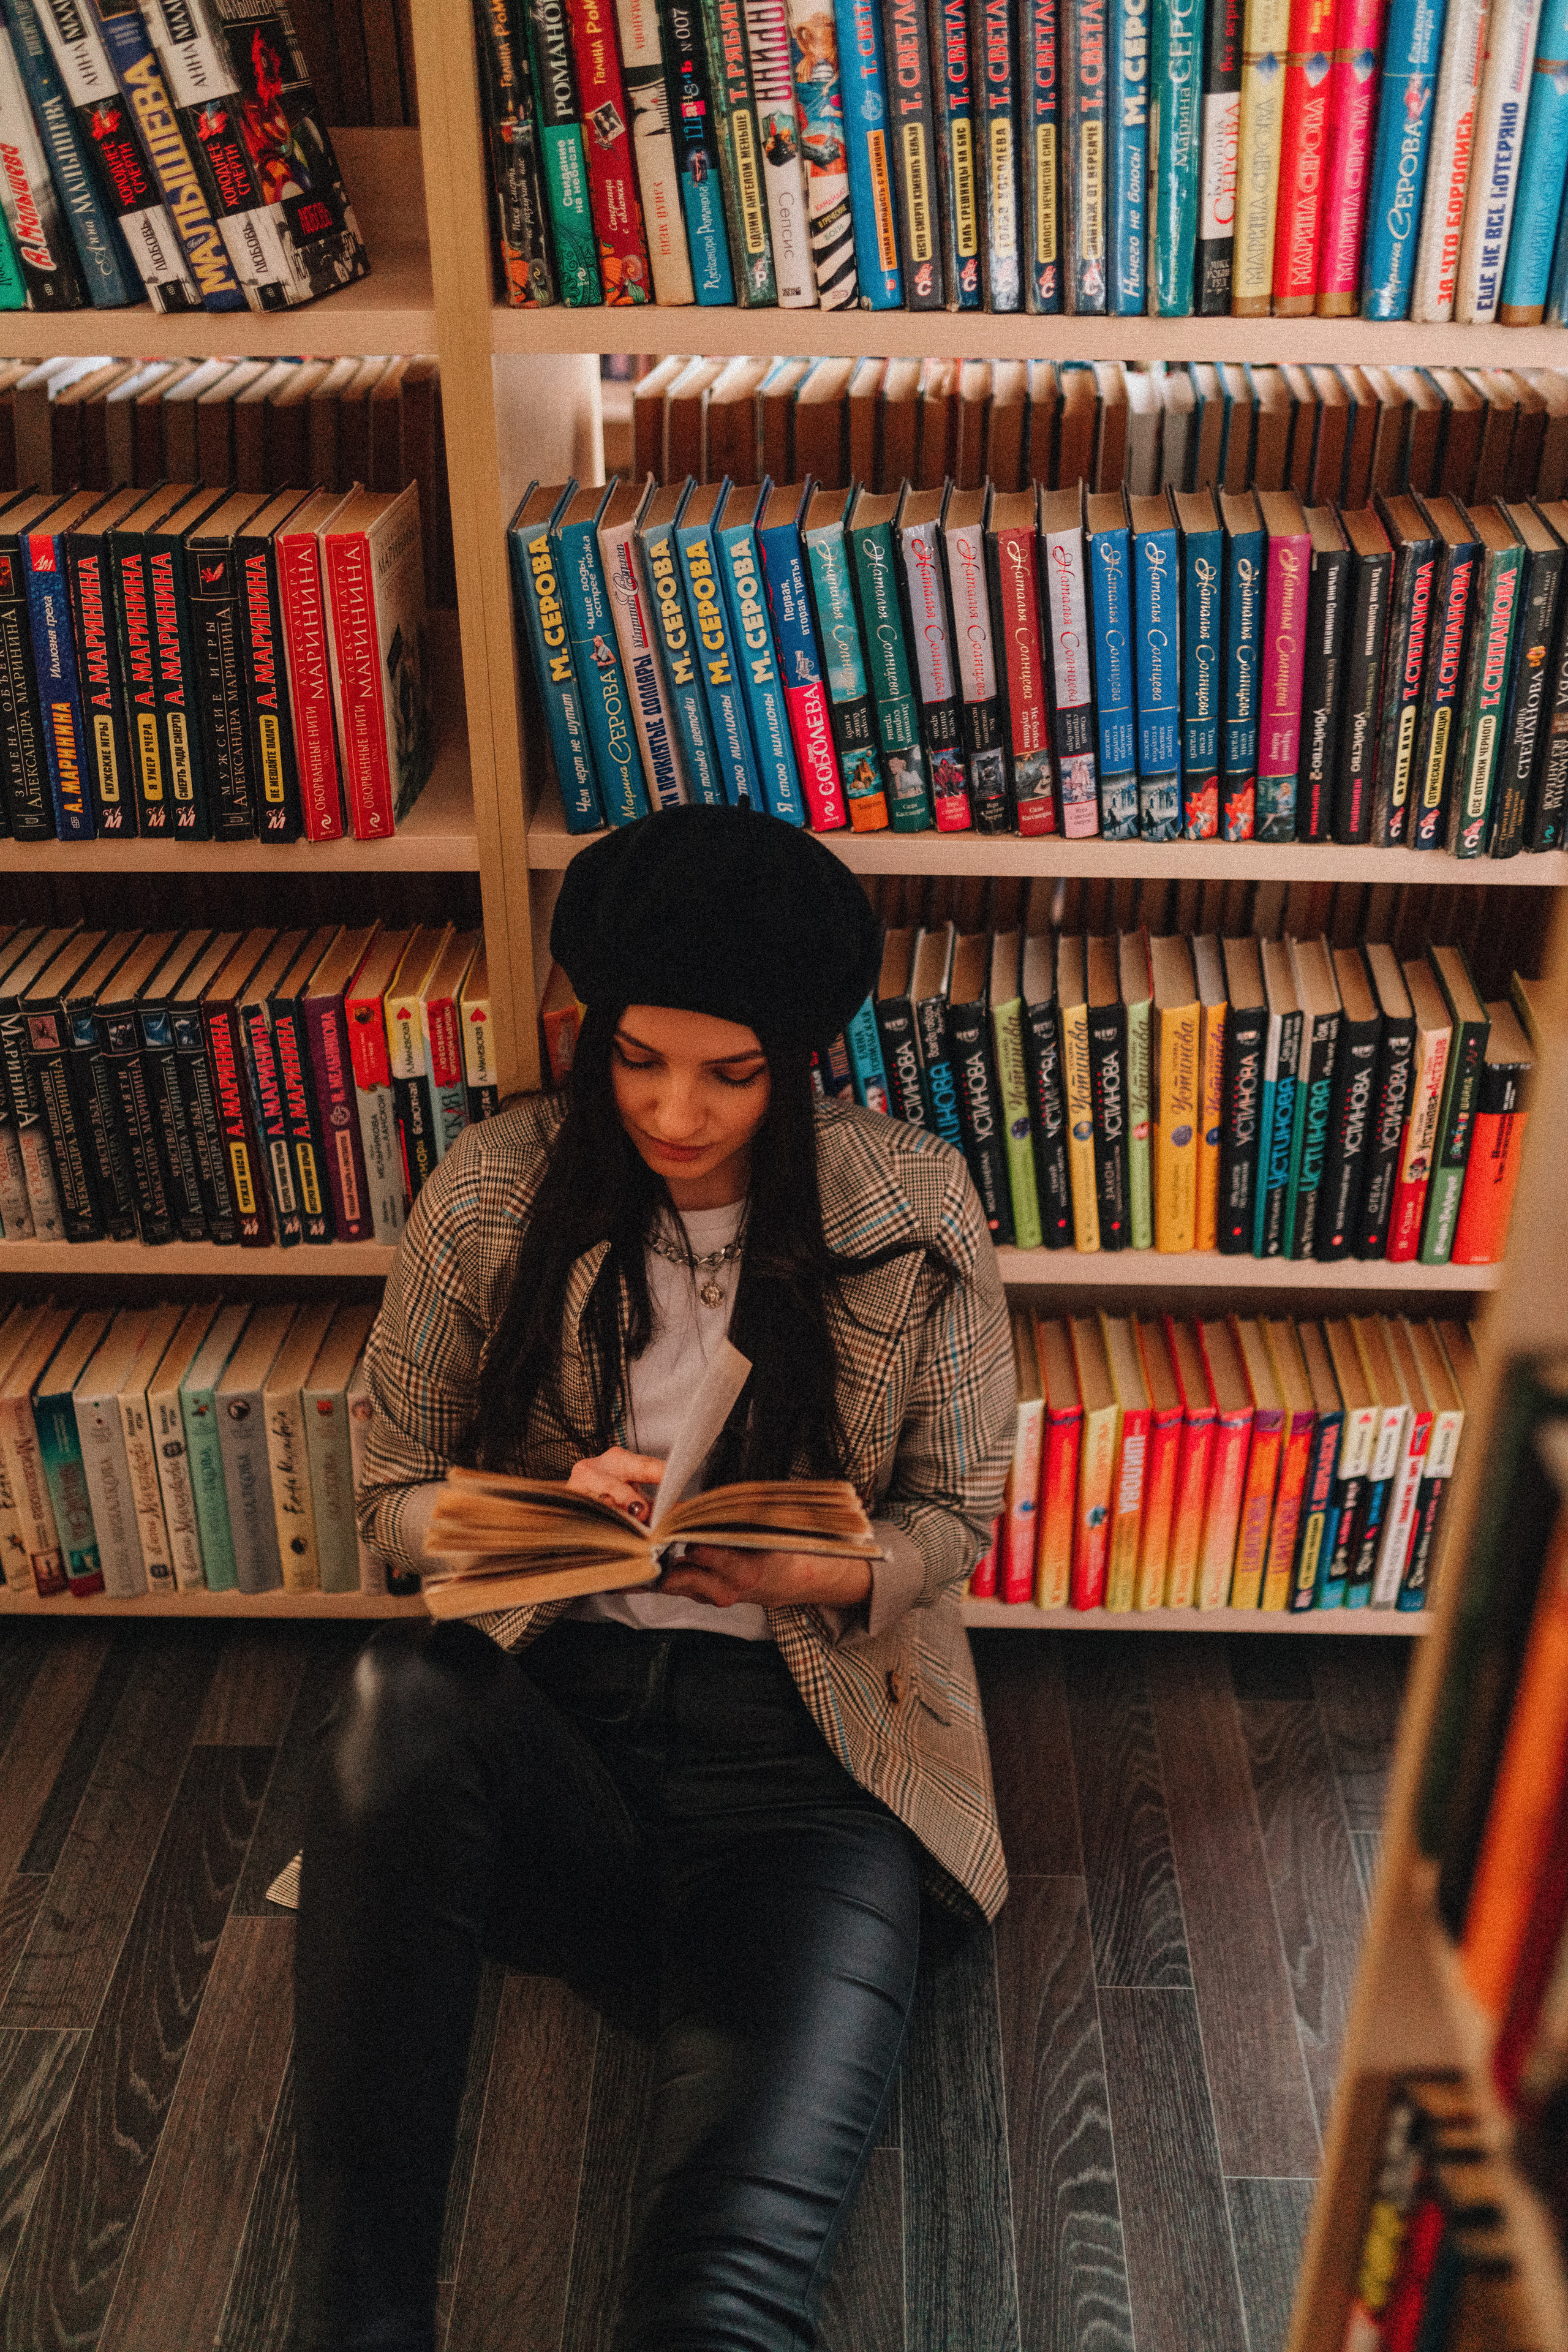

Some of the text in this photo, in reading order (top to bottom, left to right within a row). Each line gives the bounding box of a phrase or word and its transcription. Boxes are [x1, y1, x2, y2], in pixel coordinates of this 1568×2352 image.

[72, 42, 100, 86] АННА
[181, 42, 209, 88] АННА
[101, 141, 137, 206] ХОЛОДНЕЕ
[119, 141, 148, 194] СМЕРТИ
[123, 53, 238, 295] МАЛЫШЕВА
[206, 141, 241, 208] ХОЛОДНЕЕ
[225, 143, 251, 195] СМЕРТИ
[557, 140, 573, 206] Свидание
[1175, 87, 1192, 168] Марина
[1490, 102, 1518, 198] ПОТЕРЯНО
[41, 95, 112, 275] Анна МАЛЫШЕВА
[567, 138, 583, 213] на небесах
[605, 179, 618, 231] Соперница
[653, 181, 671, 255] УЗНАЙ МЕНЯ
[736, 115, 762, 247] ОДНИМ АНГЕЛОМ МЕНЬШЕ
[908, 126, 927, 258] МЕСТО СМЕРТИ ИЗМЕНИТЬ НЕЛЬЗЯ
[956, 127, 972, 249] РОЛЬ ГРЕШНИЦЫ НА БИС
[1123, 146, 1141, 297] Ничего не боюсь!
[1292, 97, 1322, 285] МАРИНА СЕРОВА
[1438, 96, 1476, 305] ЗА ЧТО БОРОЛИСЬ...
[1485, 204, 1506, 239] ВСЕ
[778, 192, 794, 258] Сепсис
[1482, 245, 1500, 267] НЕ
[298, 548, 325, 699] МАРИНИНА
[345, 546, 374, 697] МАРИНИНА
[529, 534, 571, 681] М. СЕРОВА
[578, 556, 596, 630] Чище воды,
[581, 535, 602, 617] острее ножа
[649, 538, 694, 684] М. СЕРОВА
[730, 538, 774, 684] М. СЕРОВА
[780, 579, 794, 622] Первая,
[790, 559, 810, 635] вторая, третья
[862, 539, 900, 696] Наталья Солнцева
[911, 539, 946, 696] Наталья Солнцева
[957, 539, 989, 696] Наталья Солнцева
[1006, 541, 1034, 699] Наталья Солнцева
[1145, 542, 1167, 701] Наталья Солнцева
[1324, 566, 1338, 654] Татьяна Соломатина
[1364, 567, 1382, 655] Татьяна Соломатина
[78, 556, 111, 708] А. МАРИНИНА
[151, 552, 185, 706] А. МАРИНИНА
[245, 554, 277, 709] А. МАРИНИНА
[1052, 546, 1080, 702] Наталья Солнцева
[1195, 558, 1216, 716] Наталья Солнцева
[1275, 549, 1301, 706] Наталья Солнцева
[1403, 560, 1434, 700] Т. СТЕПАНОВА
[1438, 560, 1472, 700] Т. СТЕПАНОВА
[1481, 568, 1517, 709] Т. СТЕПАНОВА
[51, 703, 83, 813] А. МАРИНИНА
[99, 722, 114, 794] МУЖСКИЕ ИГРЫ
[143, 723, 154, 753] ВЧЕРА
[171, 714, 189, 798] СМЕРТЬ РАДИ СМЕРТИ
[263, 719, 279, 798] НЕ МЕШАЙТЕ ПАЛАЧУ
[306, 706, 326, 810] ОБОРВАННЫЕ НИТИ
[355, 704, 375, 808] ОБОРВАННЫЕ НИТИ
[561, 693, 592, 812] Чем черт не шутит
[633, 654, 676, 790] ПРОКЛЯТЫЕ ДОЛЛАРЫ
[685, 697, 711, 787] только цветочки
[764, 693, 793, 813] Я стою миллионы
[803, 684, 834, 796] СОБОЛЕВА
[884, 714, 895, 741] травы
[894, 710, 903, 742] сорной
[902, 703, 913, 744] Дневник
[947, 718, 956, 737] чему
[1022, 712, 1031, 748] глубины
[1031, 706, 1038, 720] Не
[1396, 717, 1412, 795] ВРАТА НОЧИ
[1427, 710, 1447, 805] ГОТИЧЕСКАЯ КОЛЛЕКЦИЯ
[1517, 669, 1544, 779] СТЕПАНОВА
[146, 756, 156, 781] УМЕР
[1472, 718, 1493, 814] ВСЕ ОТТЕНКИ ЧЕРНОГО
[209, 1012, 246, 1137] А. МАРИНИНА
[249, 1014, 282, 1116] МАРИНИНА
[276, 1016, 306, 1118] МАРИНИНА
[965, 1051, 994, 1142] УСТИНОВА
[1071, 1020, 1091, 1114] Устинова
[1102, 1050, 1122, 1140] УСТИНОВА
[1172, 1020, 1194, 1115] Устинова
[1235, 1052, 1259, 1146] УСТИНОВА
[1379, 1058, 1410, 1153] УСТИНОВА
[88, 1098, 111, 1178] ЧУВСТВО ЛЬДА
[267, 1117, 285, 1135] А.
[293, 1121, 311, 1139] А.
[371, 1114, 386, 1179] МЕЛЬНИКОВА
[1267, 1076, 1295, 1189] УСТИНОВА
[1298, 1080, 1330, 1191] УСТИНОВА
[1343, 1068, 1371, 1158] УСТИНОВА
